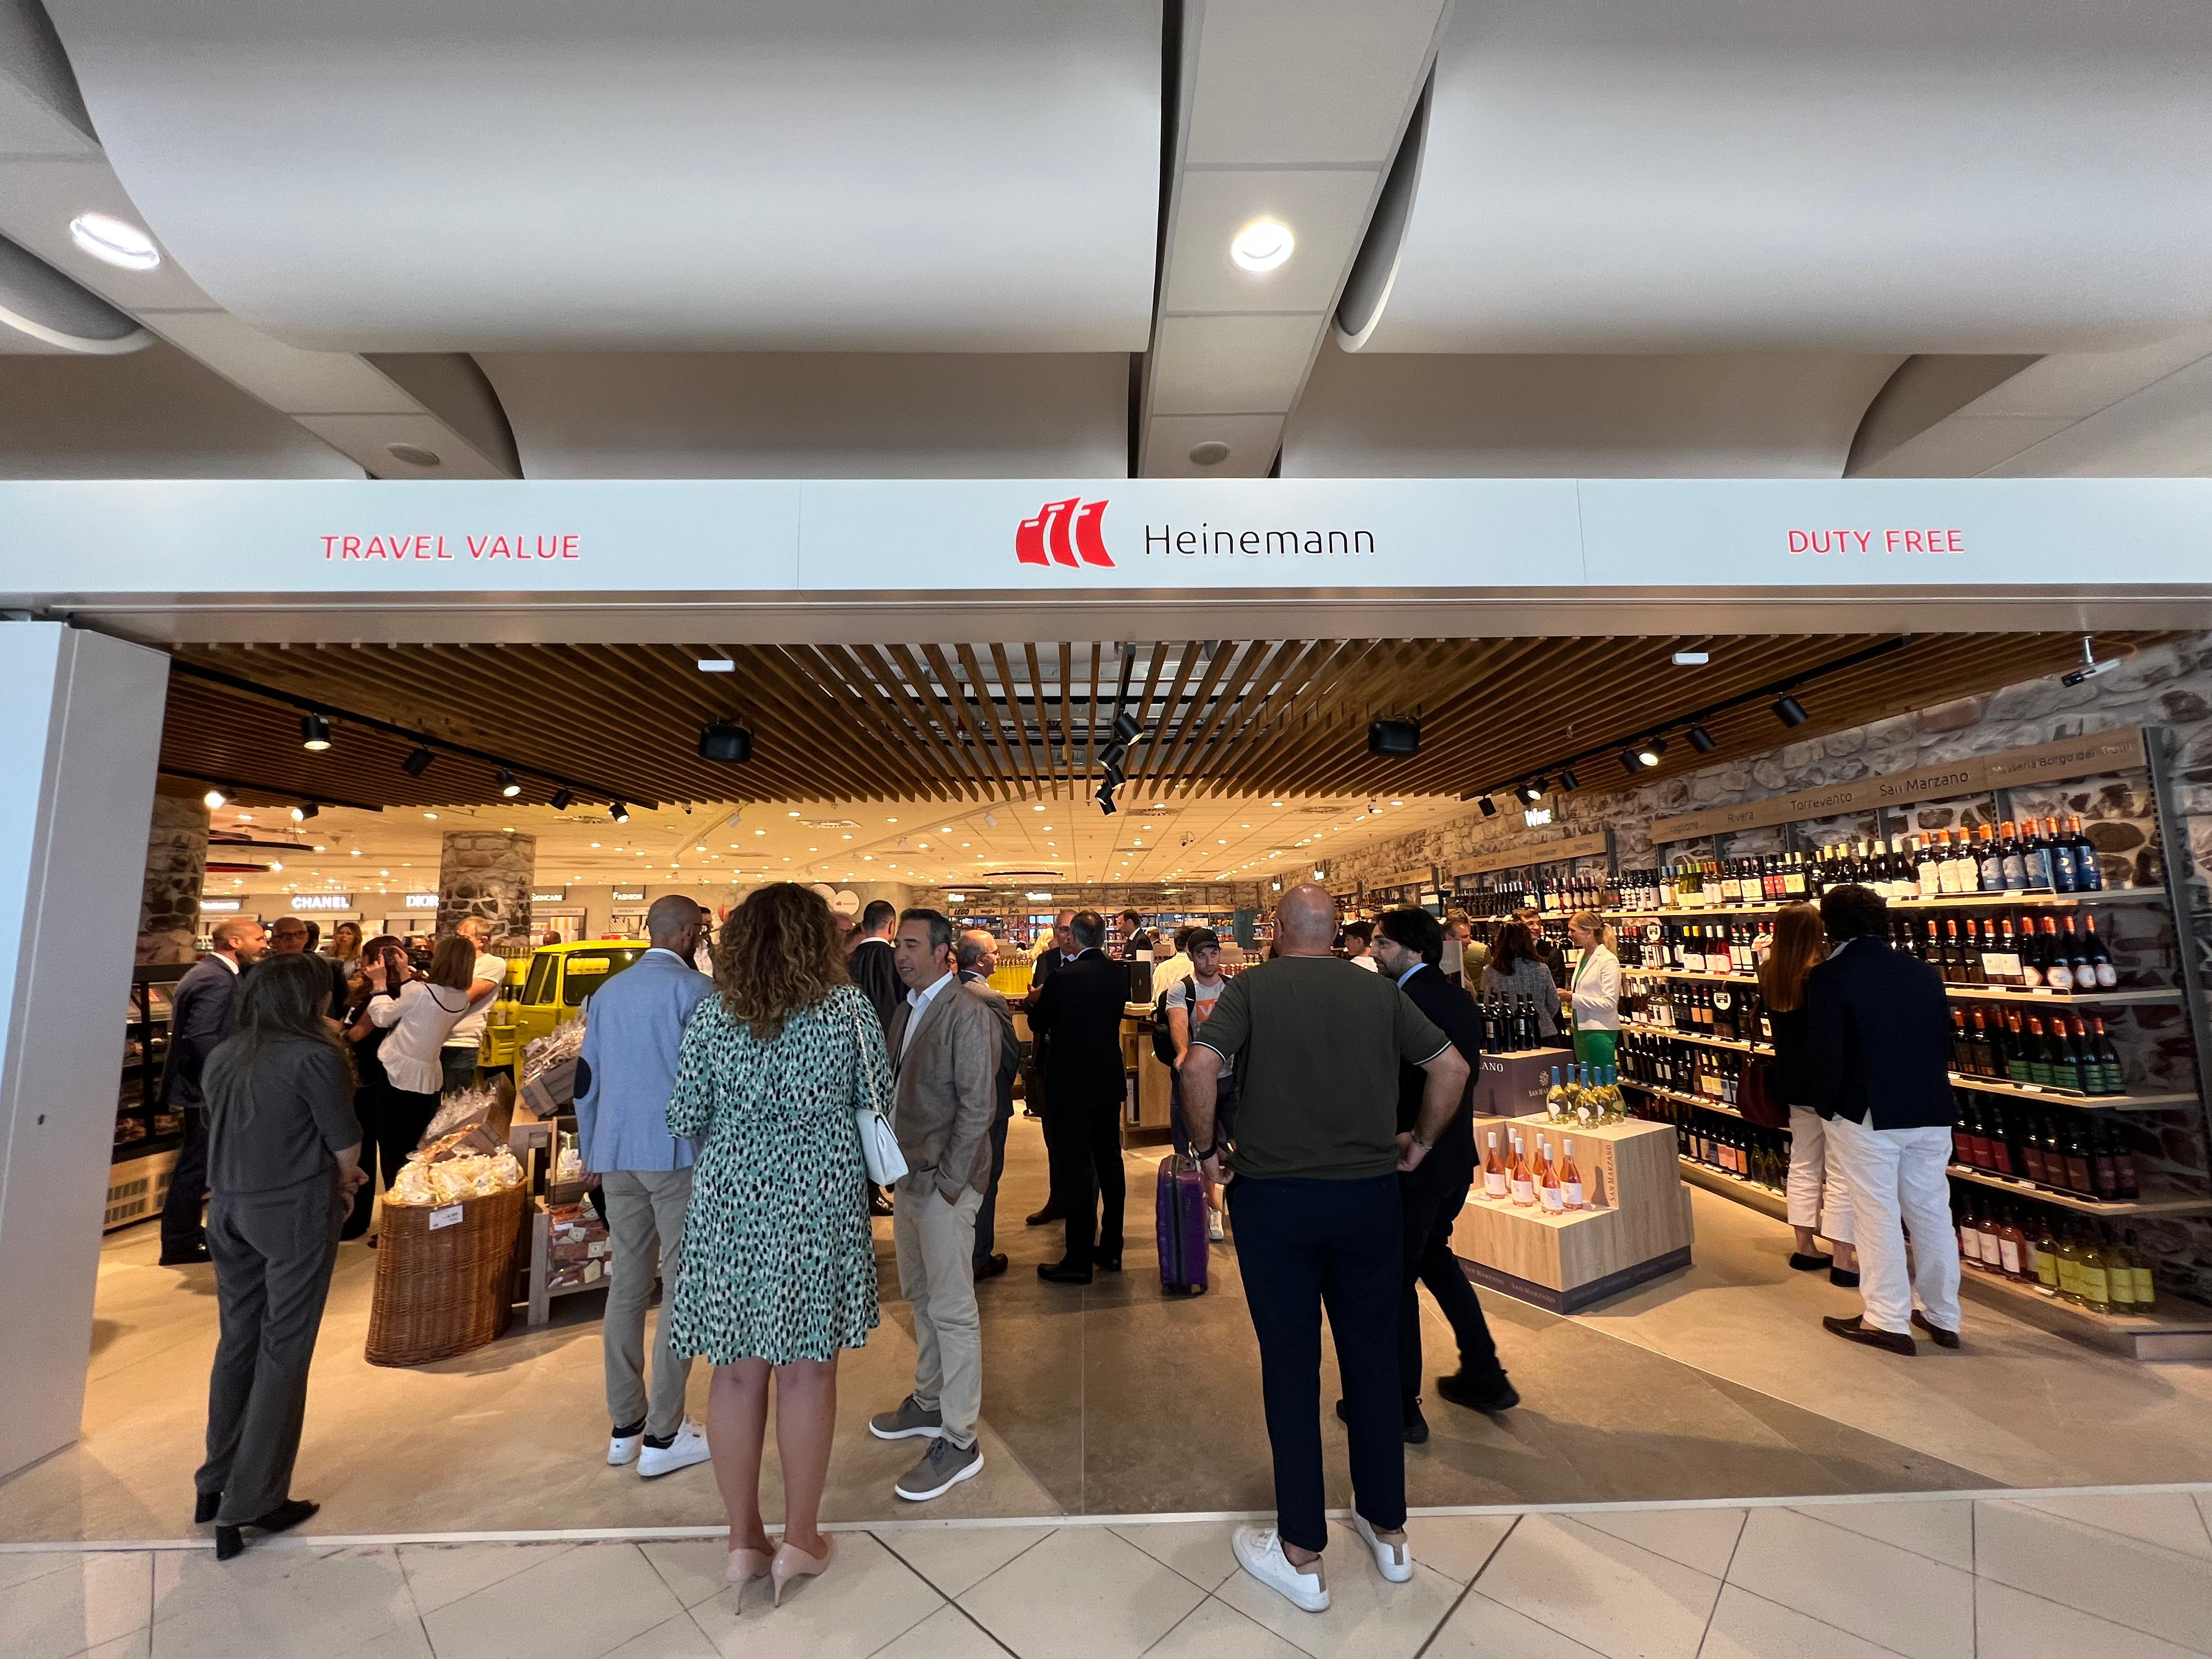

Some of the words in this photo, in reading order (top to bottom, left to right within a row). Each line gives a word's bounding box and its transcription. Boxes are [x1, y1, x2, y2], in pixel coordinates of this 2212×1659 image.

[319, 535, 455, 561] TRAVEL
[466, 535, 580, 560] VALUE
[1144, 522, 1375, 555] Heinemann
[1787, 529, 1871, 554] DUTY
[1884, 529, 1965, 554] FREE
[2039, 753, 2074, 767] Borgo
[1880, 784, 1904, 797] San
[1906, 771, 1969, 792] Marzano
[1791, 792, 1853, 812] Torrevento
[1728, 811, 1754, 822] Rivera
[292, 896, 350, 909] CHANEL
[1480, 1061, 1503, 1073] ANO
[1605, 1144, 1615, 1185] MARZANO
